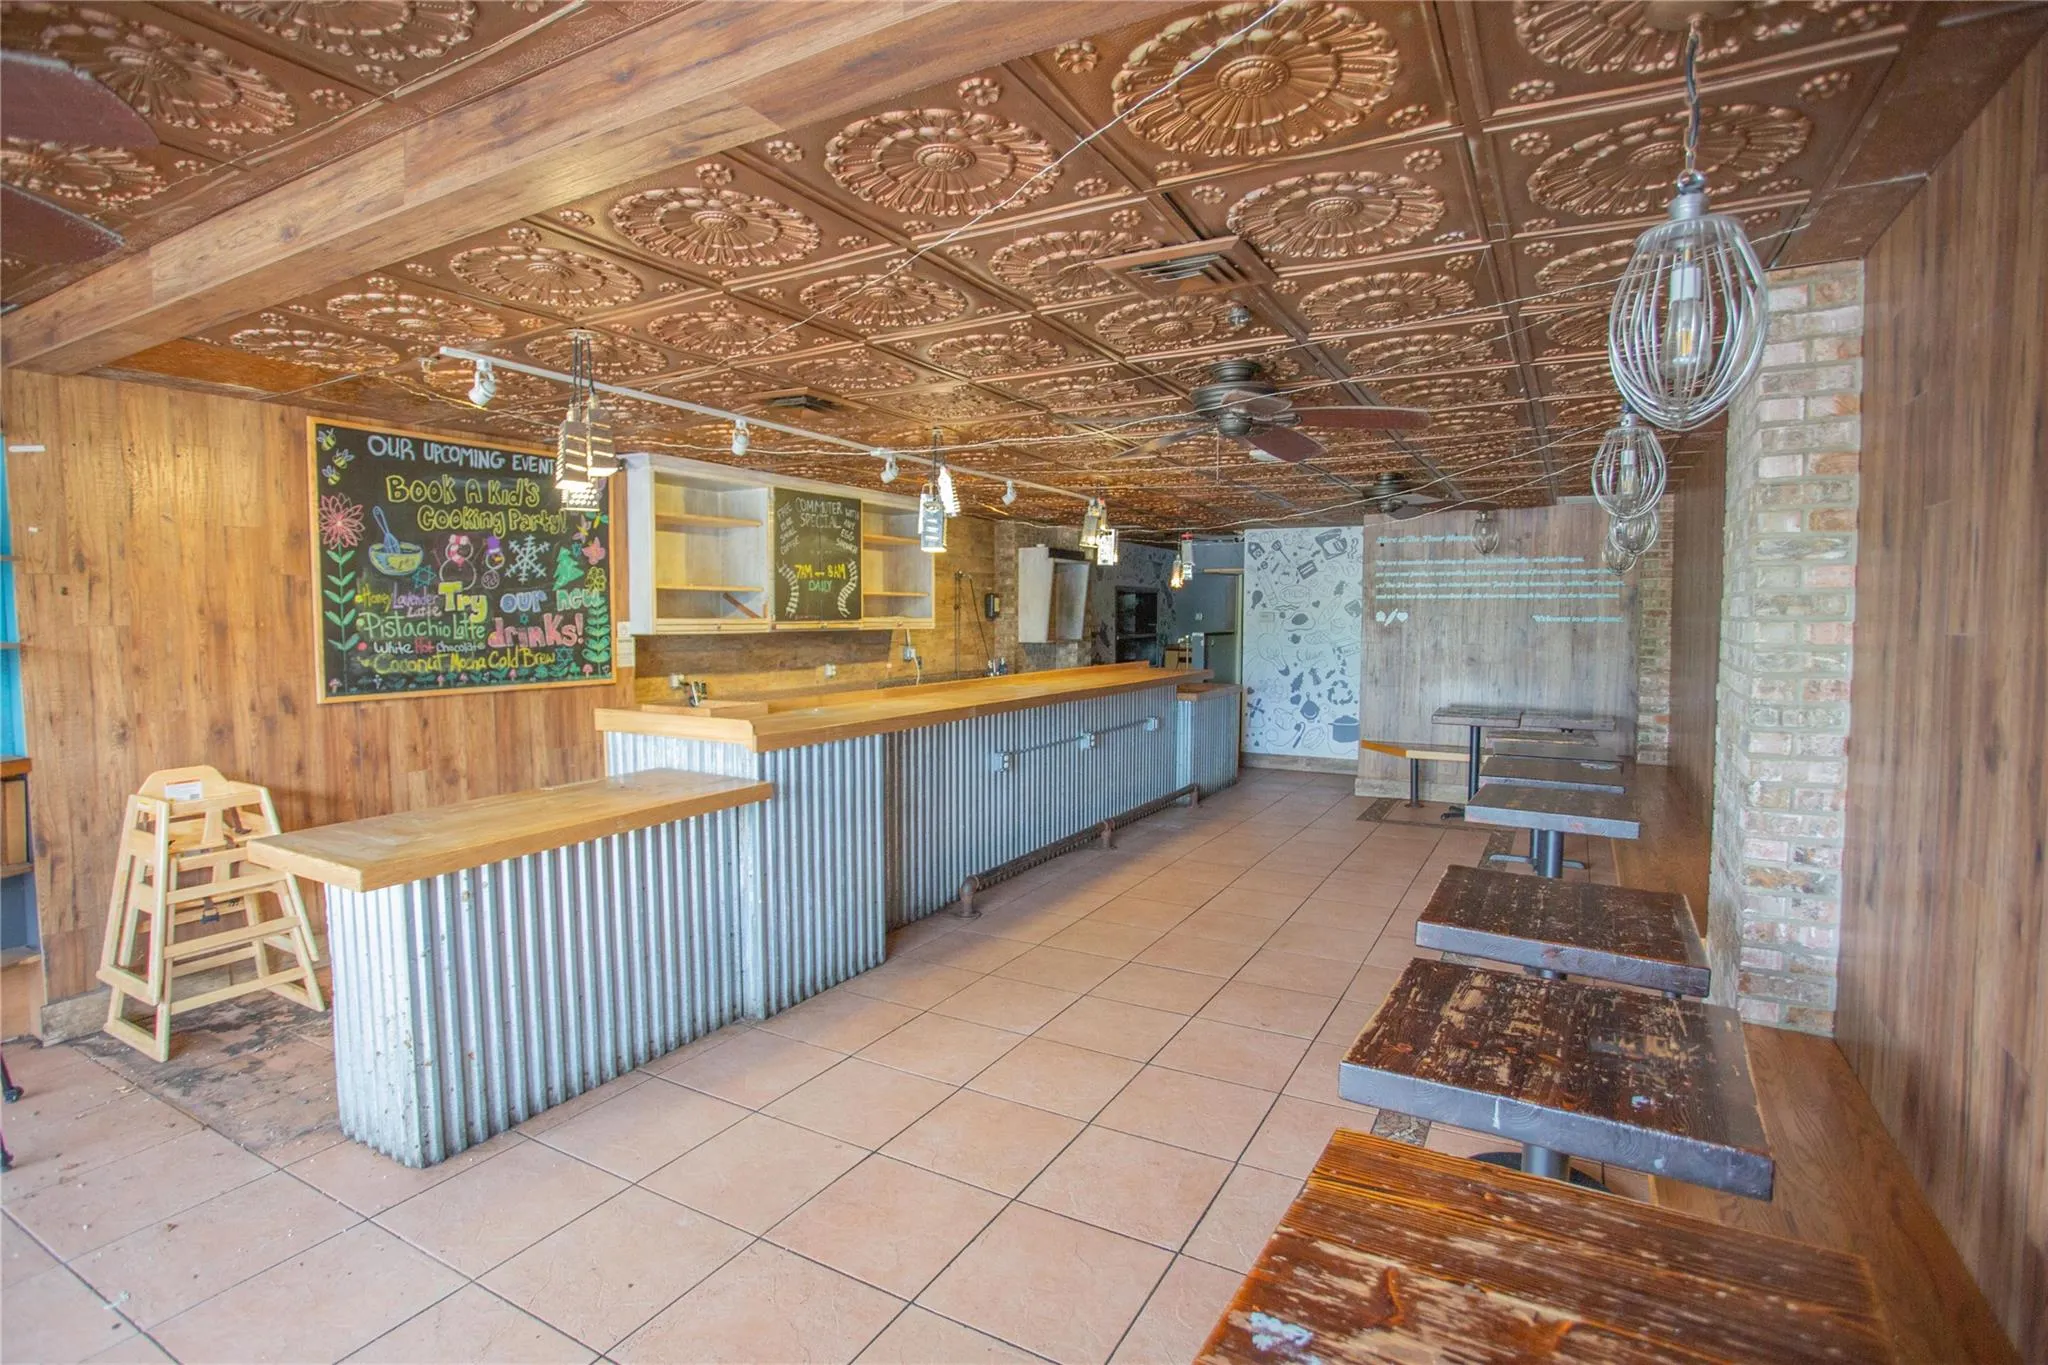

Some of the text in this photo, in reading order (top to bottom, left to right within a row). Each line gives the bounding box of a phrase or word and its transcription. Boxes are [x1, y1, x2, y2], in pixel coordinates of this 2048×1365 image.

[367, 435, 416, 462] OUR
[423, 441, 506, 469] UPCOMING
[385, 473, 456, 505] Book
[465, 478, 482, 504] A
[795, 497, 843, 516] COMMUTER
[800, 512, 842, 529] SPECIAL
[794, 563, 813, 579] 7AM
[827, 563, 846, 580] 8AM
[438, 581, 601, 623] Try our new
[359, 611, 486, 640] Pistachio Latte
[372, 653, 448, 675] Coconut
[487, 646, 520, 669] Cold
[520, 644, 556, 668] Brew
